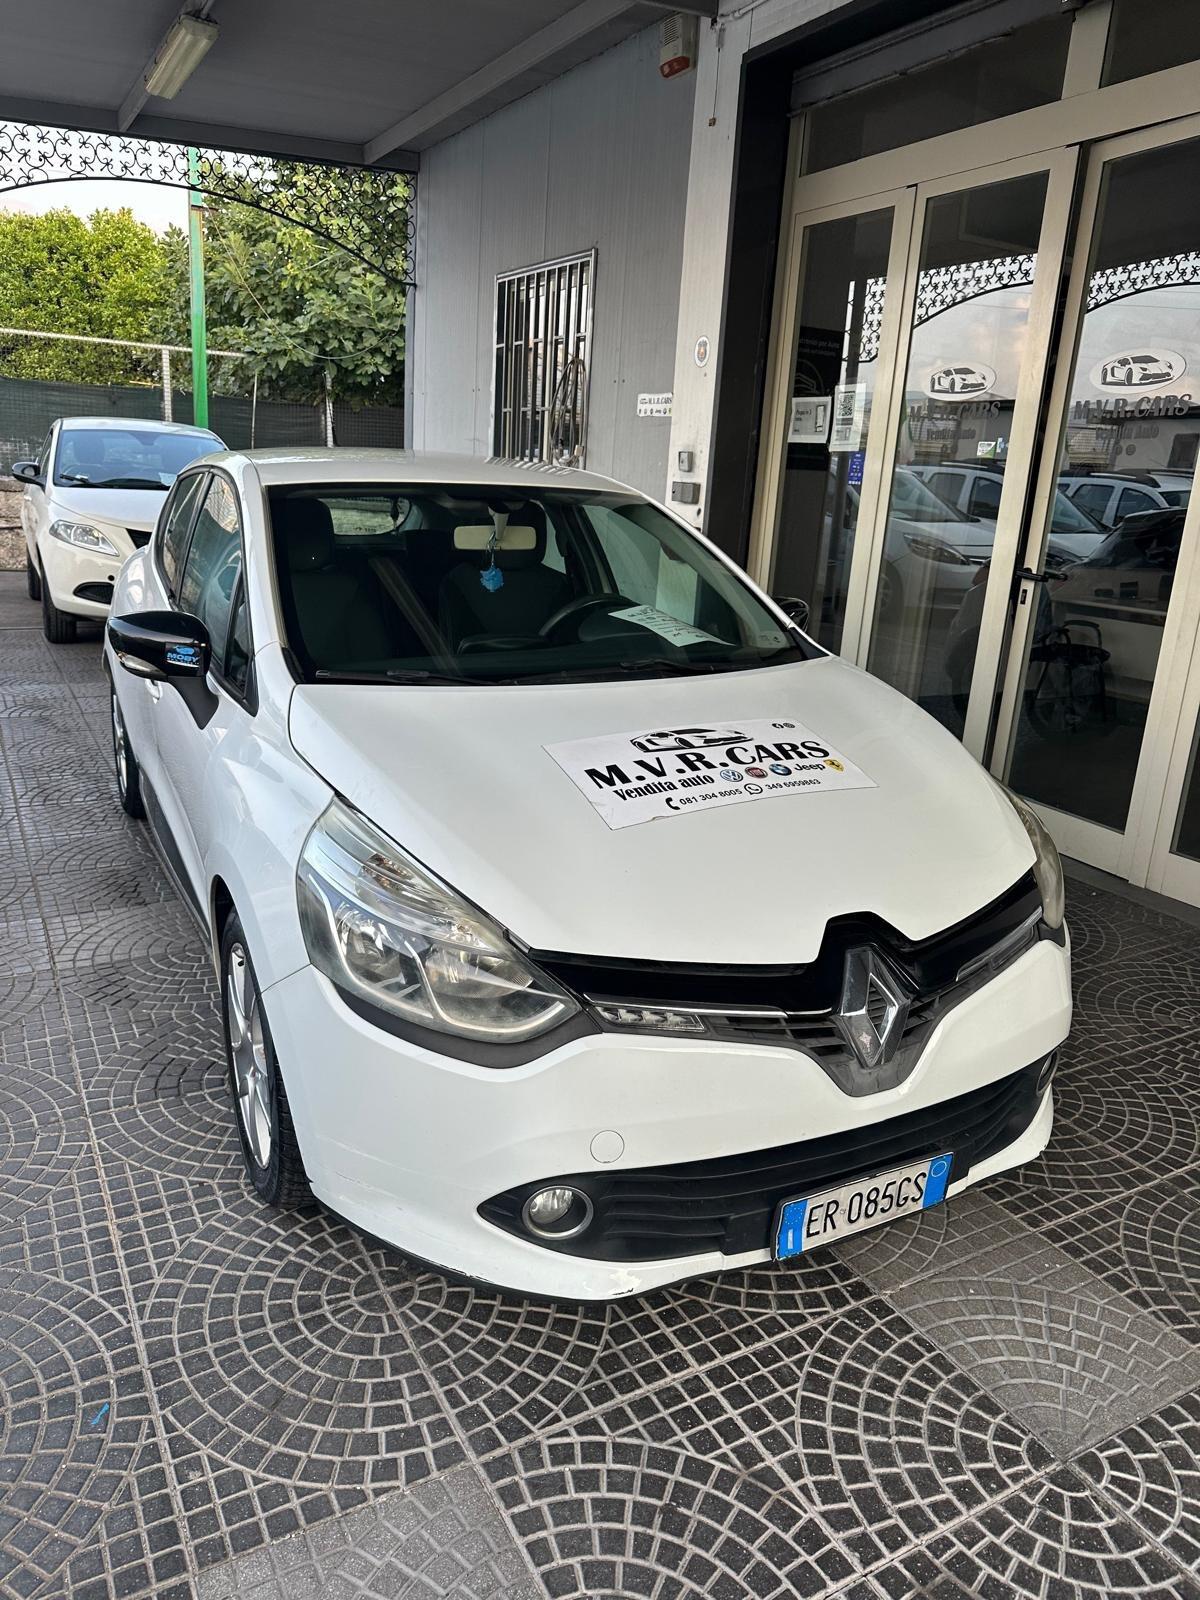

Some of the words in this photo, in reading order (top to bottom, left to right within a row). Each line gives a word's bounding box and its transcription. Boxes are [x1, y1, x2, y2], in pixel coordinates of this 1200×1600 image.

[1073, 393, 1193, 420] M.V.R.CARS
[584, 740, 830, 789] M.V.R.CARS
[794, 762, 826, 773] Jeep
[612, 780, 678, 801] Vendita
[678, 774, 715, 788] auto
[679, 796, 699, 805] 081
[699, 792, 718, 801] 304
[718, 788, 743, 798] 8005
[765, 782, 783, 790] 349
[806, 1199, 840, 1239] ER
[847, 1171, 927, 1224] 085GS
